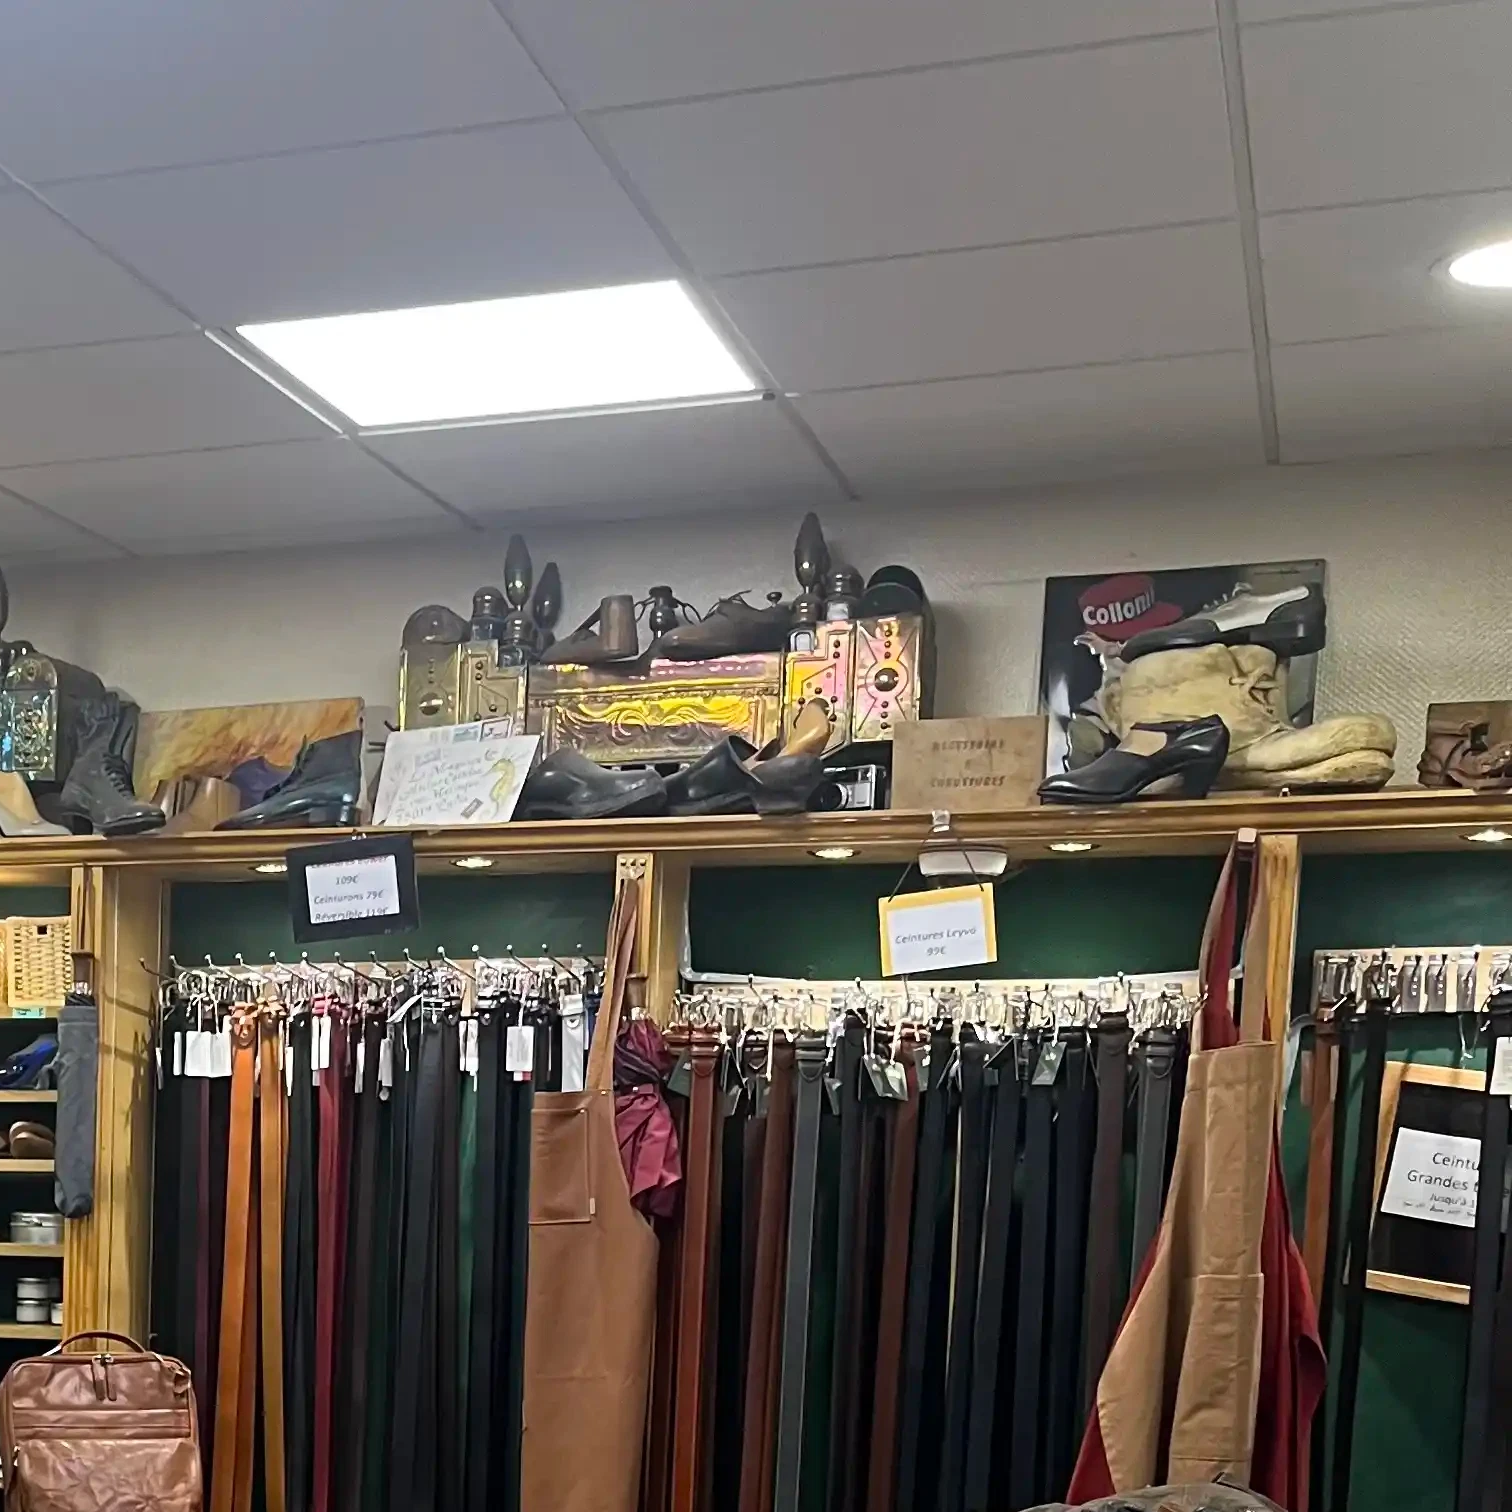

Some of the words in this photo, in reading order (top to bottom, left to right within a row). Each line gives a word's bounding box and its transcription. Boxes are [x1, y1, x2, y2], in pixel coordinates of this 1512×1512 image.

[313, 893, 364, 905] Ceinturons
[895, 931, 944, 944] Ceintures
[1407, 1169, 1469, 1191] Grandes
